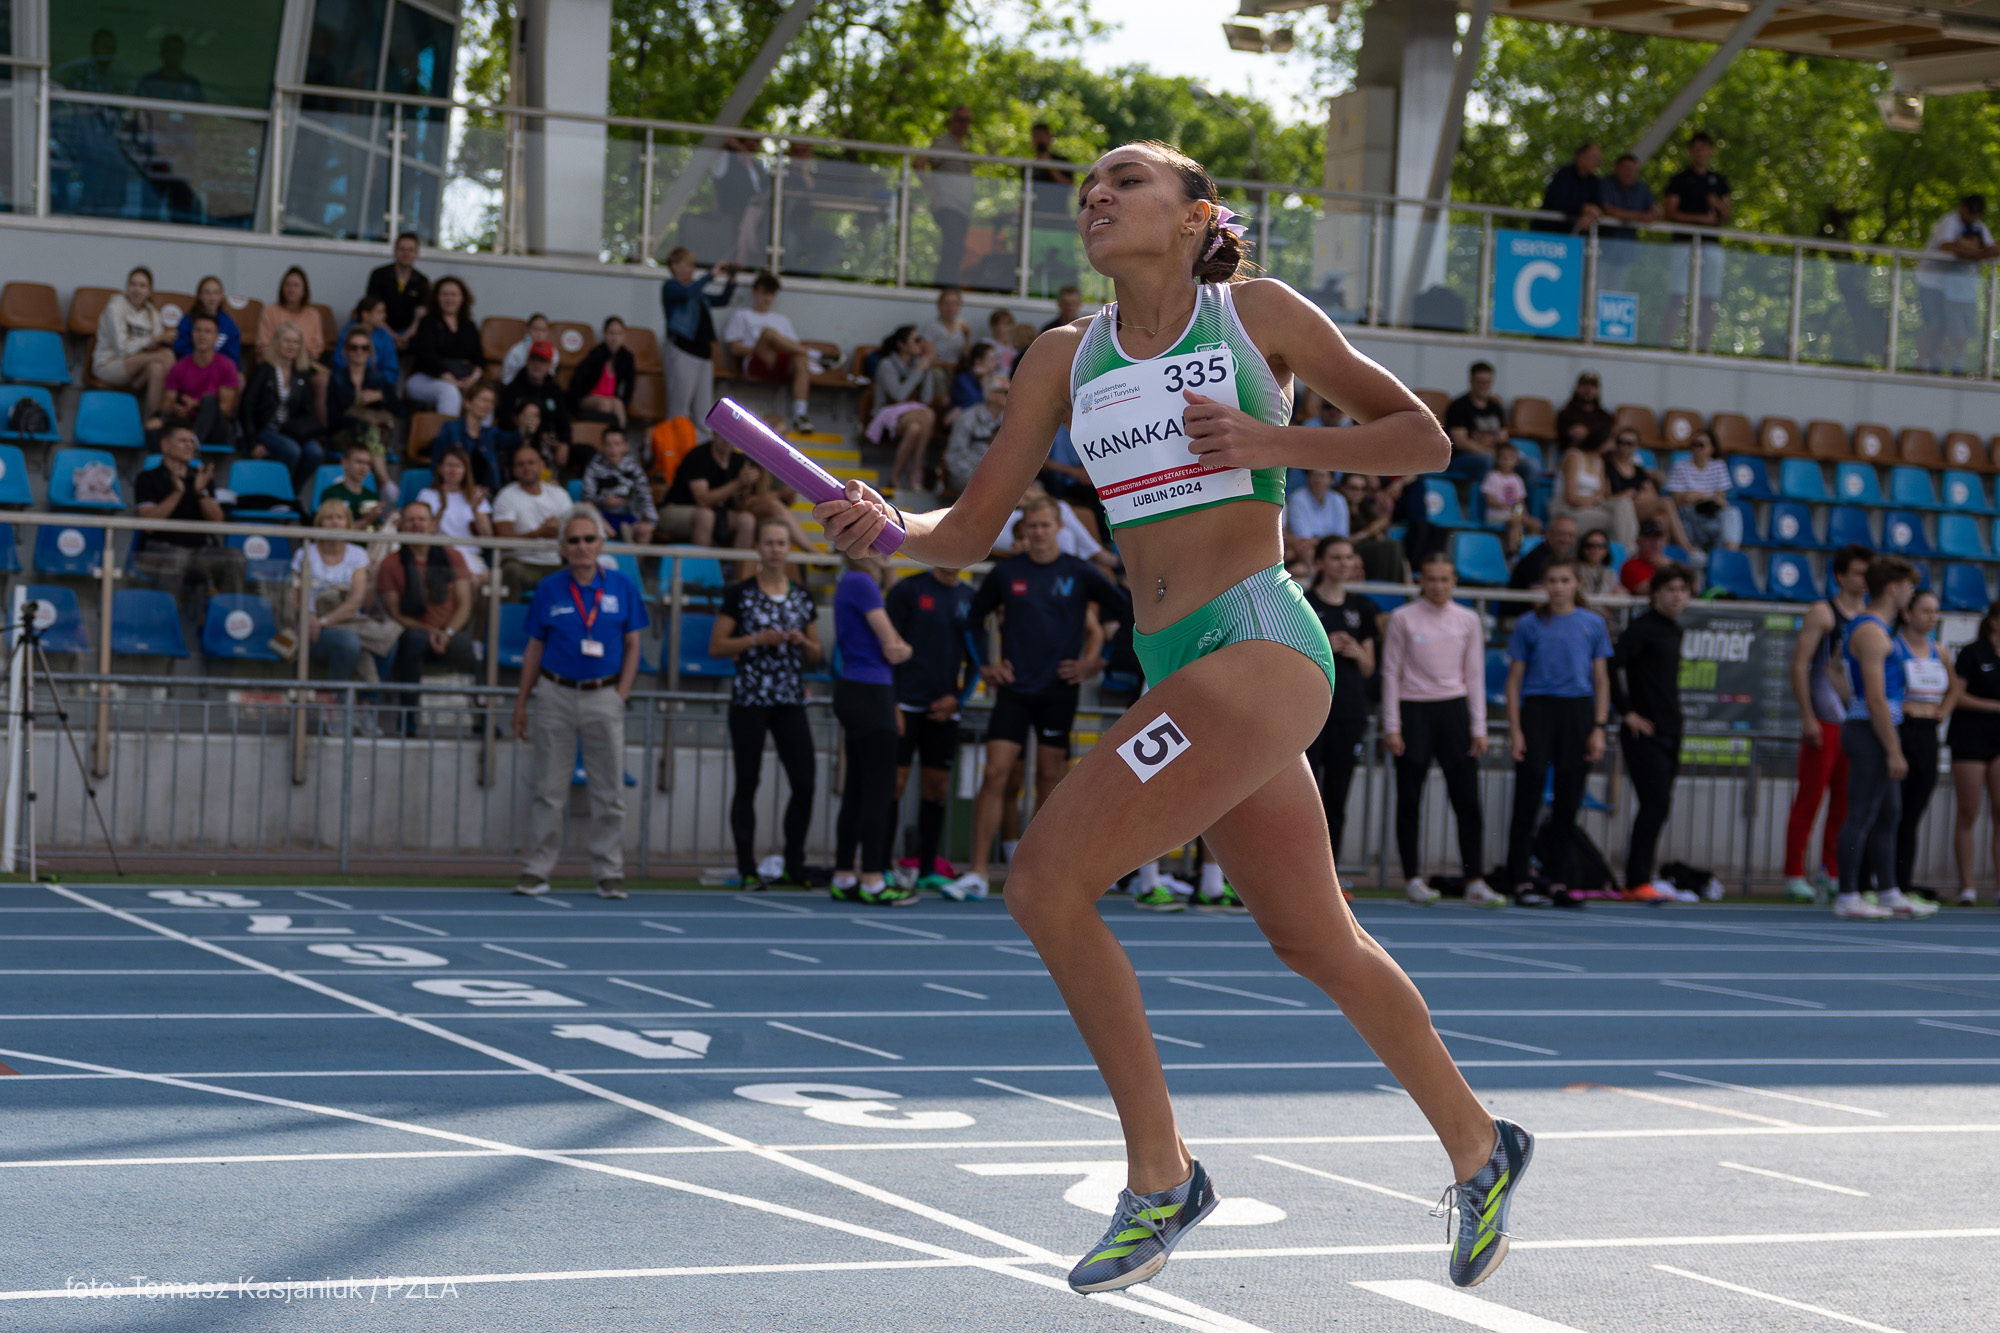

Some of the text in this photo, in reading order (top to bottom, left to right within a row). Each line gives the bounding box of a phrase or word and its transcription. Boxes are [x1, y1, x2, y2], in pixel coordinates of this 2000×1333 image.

[1510, 238, 1568, 259] SEKTOR
[1512, 260, 1563, 328] C
[1601, 301, 1635, 324] WC
[1163, 356, 1227, 393] 335
[1093, 382, 1127, 397] Ministerstwo
[1093, 394, 1110, 405] Sportu
[1113, 385, 1141, 398] Turystyki
[1113, 480, 1142, 494] MISTRZOSTWA
[1141, 477, 1157, 486] POLSKI
[1163, 466, 1203, 481] SZTAFETACH
[1132, 481, 1203, 508] LUBLIN 2024
[1680, 629, 1756, 662] unner
[1133, 721, 1185, 766] 5
[412, 979, 587, 1007] 5
[551, 1023, 713, 1059] 4
[733, 1082, 977, 1130] 3
